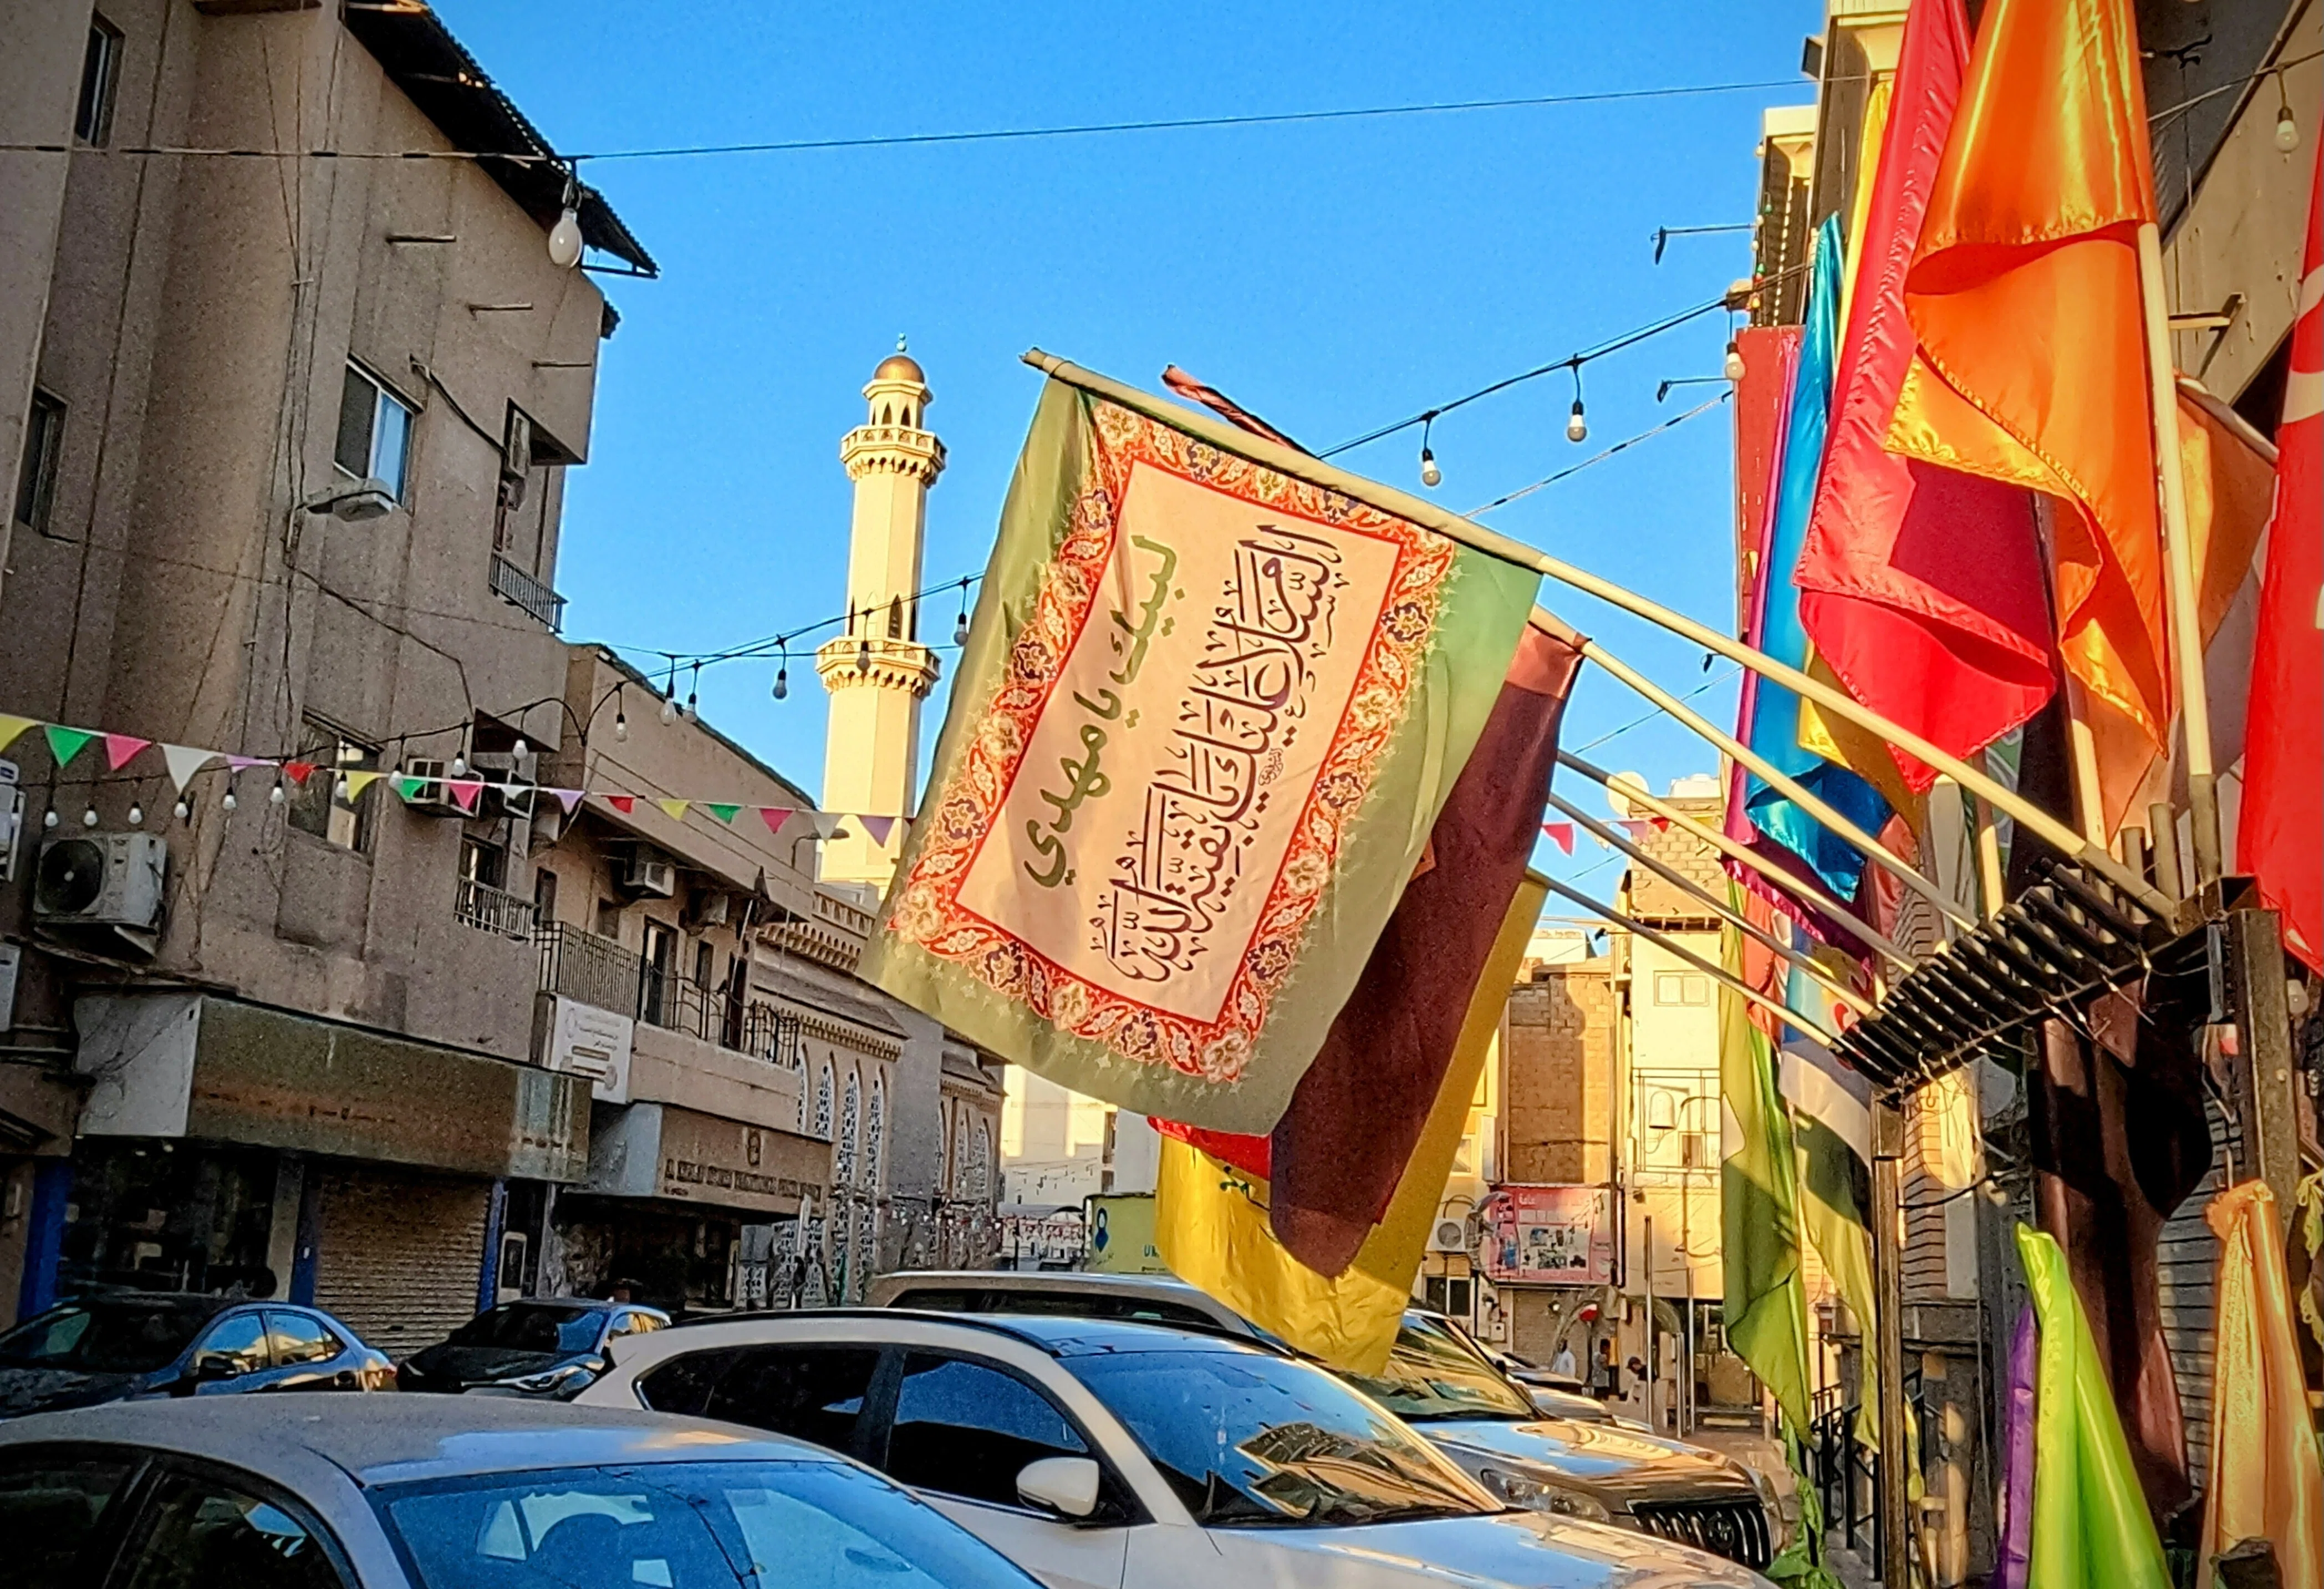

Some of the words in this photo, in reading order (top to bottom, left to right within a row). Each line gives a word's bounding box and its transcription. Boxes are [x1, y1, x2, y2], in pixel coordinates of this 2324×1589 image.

[1108, 534, 1188, 685] لبيك
[1072, 686, 1141, 730] يا
[1022, 722, 1110, 889] مهدي
